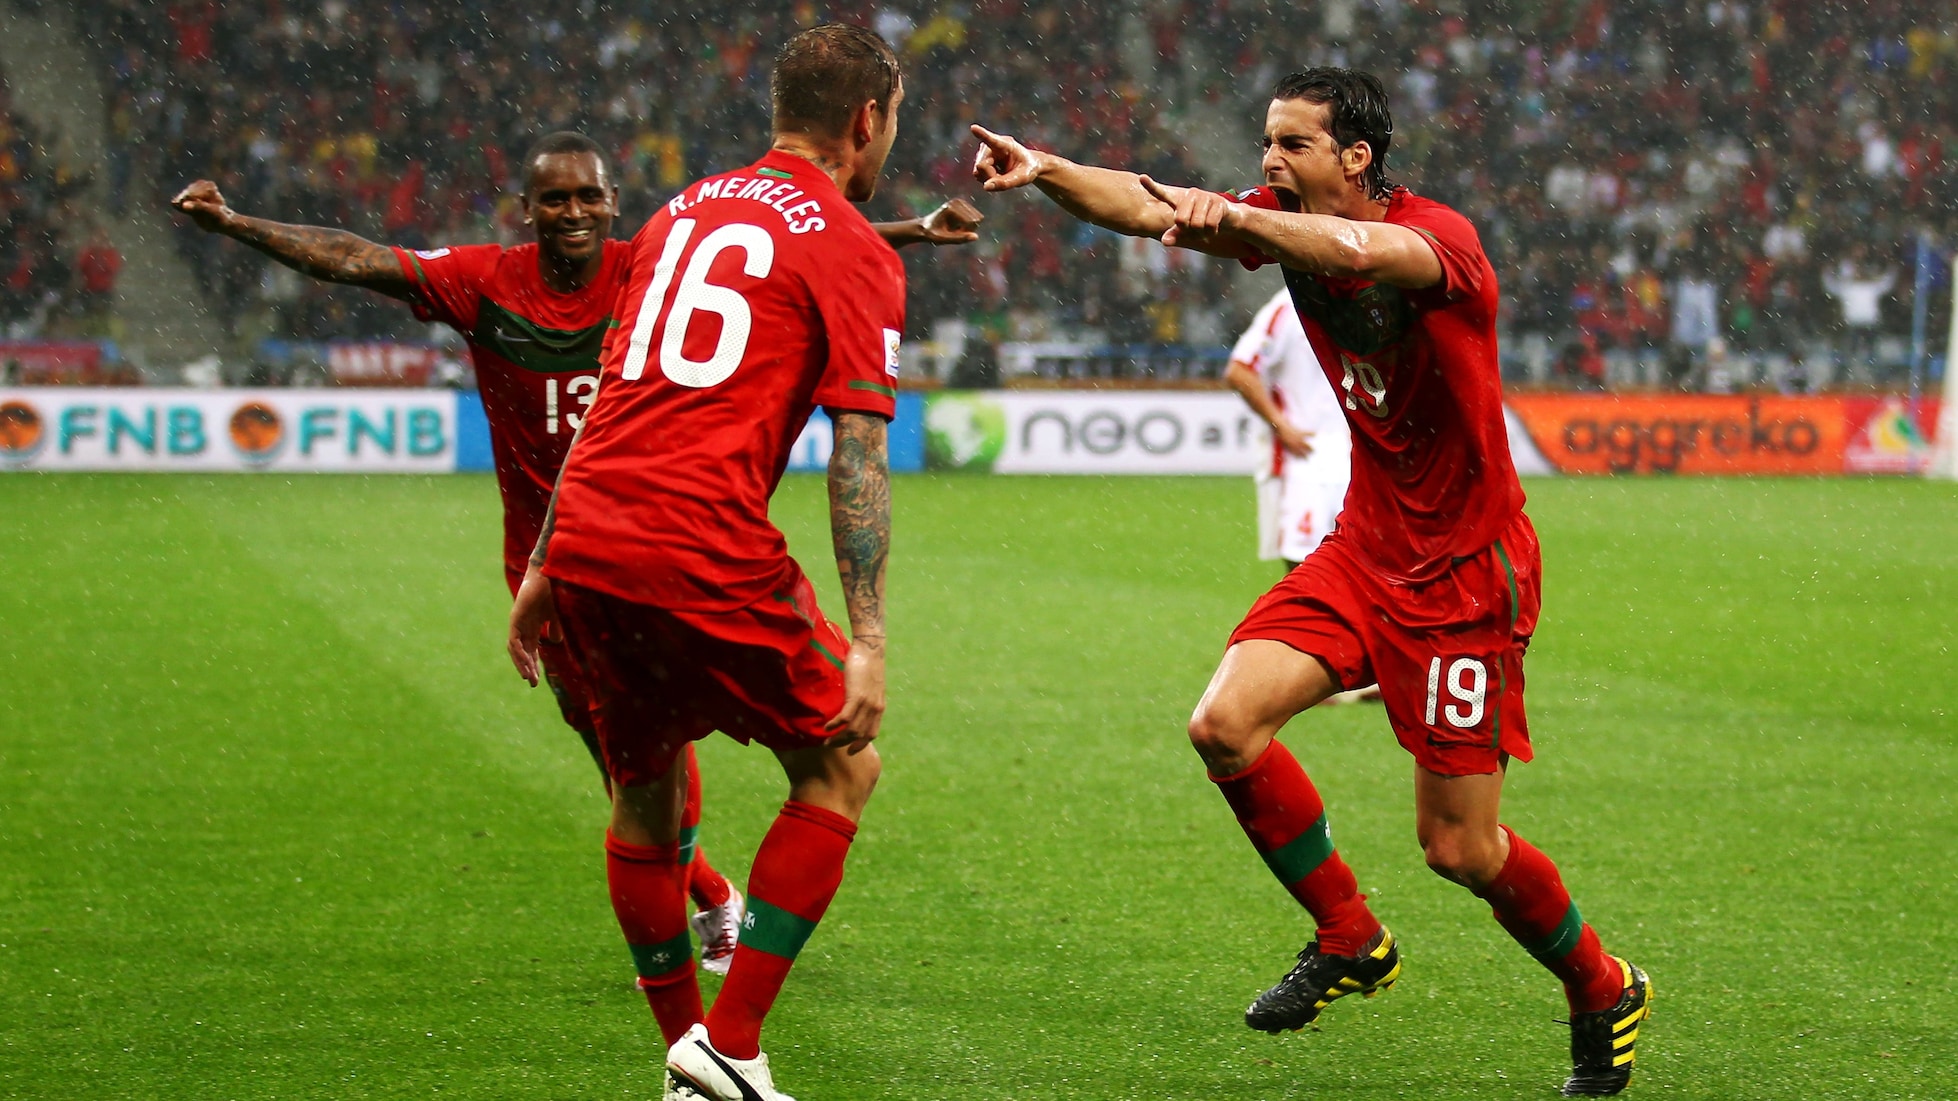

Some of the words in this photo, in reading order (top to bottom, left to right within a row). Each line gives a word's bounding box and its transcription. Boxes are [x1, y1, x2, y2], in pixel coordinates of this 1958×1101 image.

[668, 177, 826, 234] R.MEIRELES
[621, 218, 775, 388] 16
[546, 375, 600, 434] 13
[1340, 353, 1389, 418] 19
[57, 405, 206, 455] FNB
[300, 407, 445, 456] FNB
[1021, 410, 1185, 456] neo
[1563, 397, 1820, 473] aggreko
[1425, 656, 1488, 728] 19
